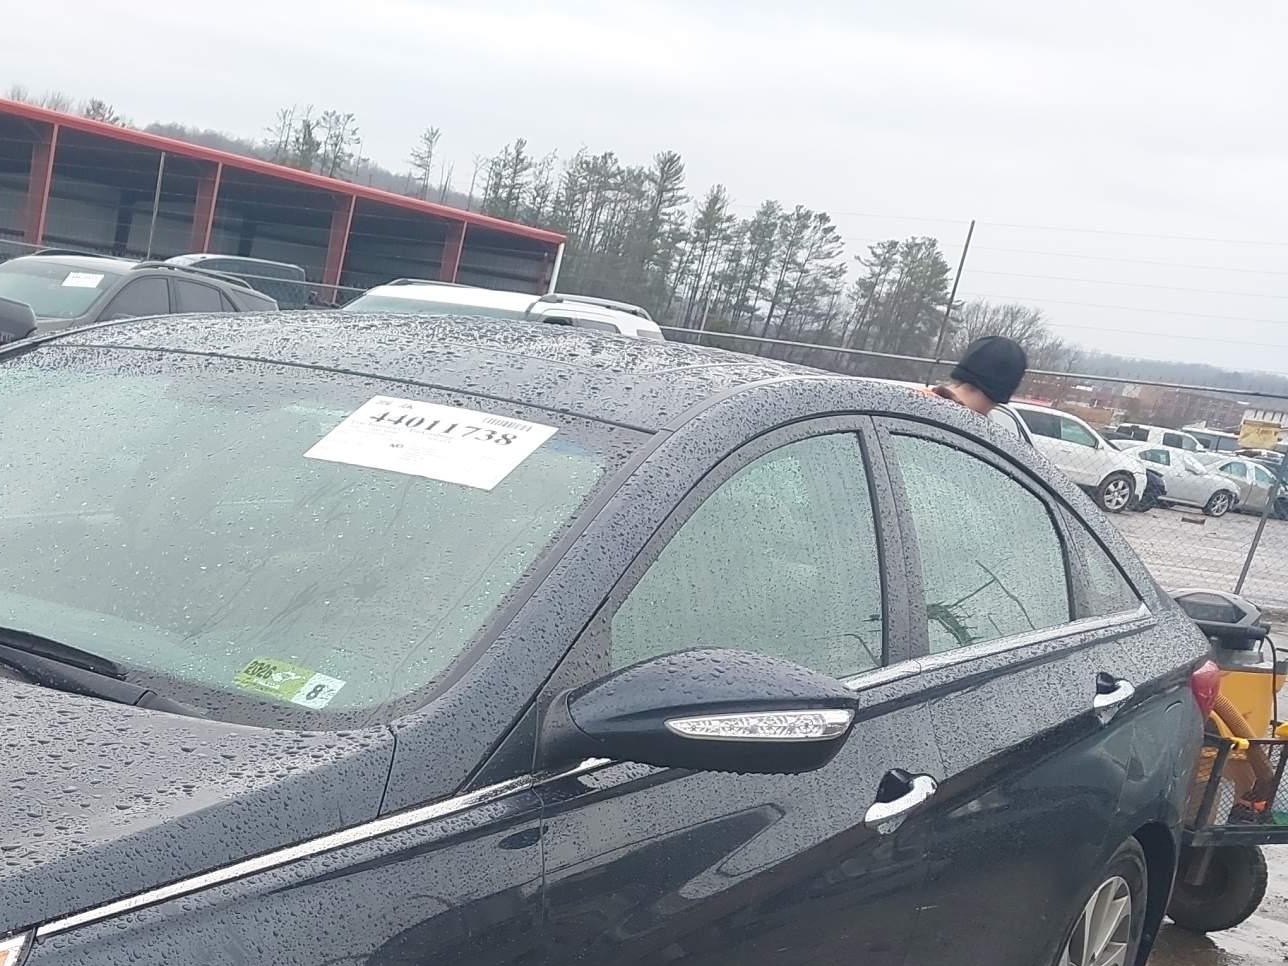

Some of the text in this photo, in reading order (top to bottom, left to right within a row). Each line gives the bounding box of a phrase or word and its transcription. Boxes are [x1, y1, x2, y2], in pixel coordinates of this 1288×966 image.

[370, 411, 517, 446] 44011738
[244, 660, 278, 680] 2026
[305, 684, 326, 701] 8
